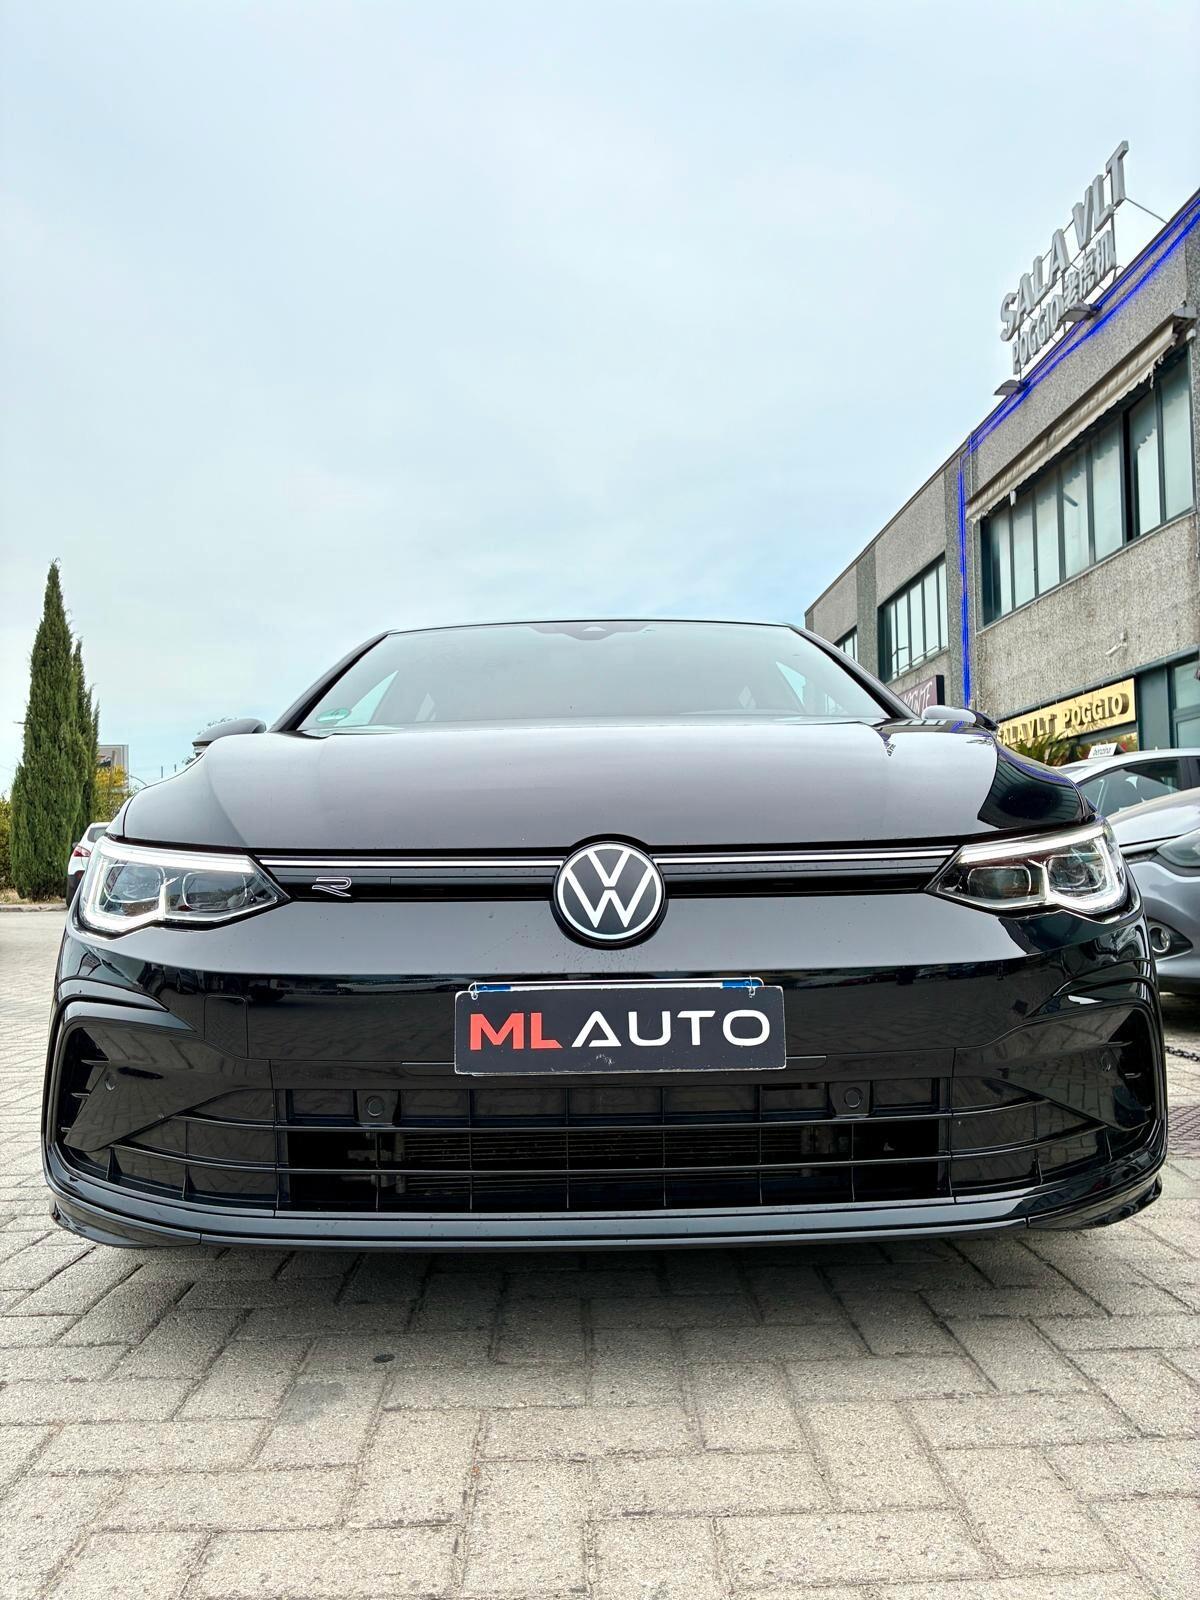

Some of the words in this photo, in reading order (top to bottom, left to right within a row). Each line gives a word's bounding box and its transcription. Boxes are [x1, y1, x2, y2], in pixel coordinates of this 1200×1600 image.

[1000, 228, 1071, 342] SALA
[1072, 140, 1129, 251] VLT
[1013, 294, 1065, 375] POGGIO
[1064, 692, 1129, 728] POGGIO
[469, 1012, 563, 1051] ML
[571, 1009, 770, 1048] AUTO
